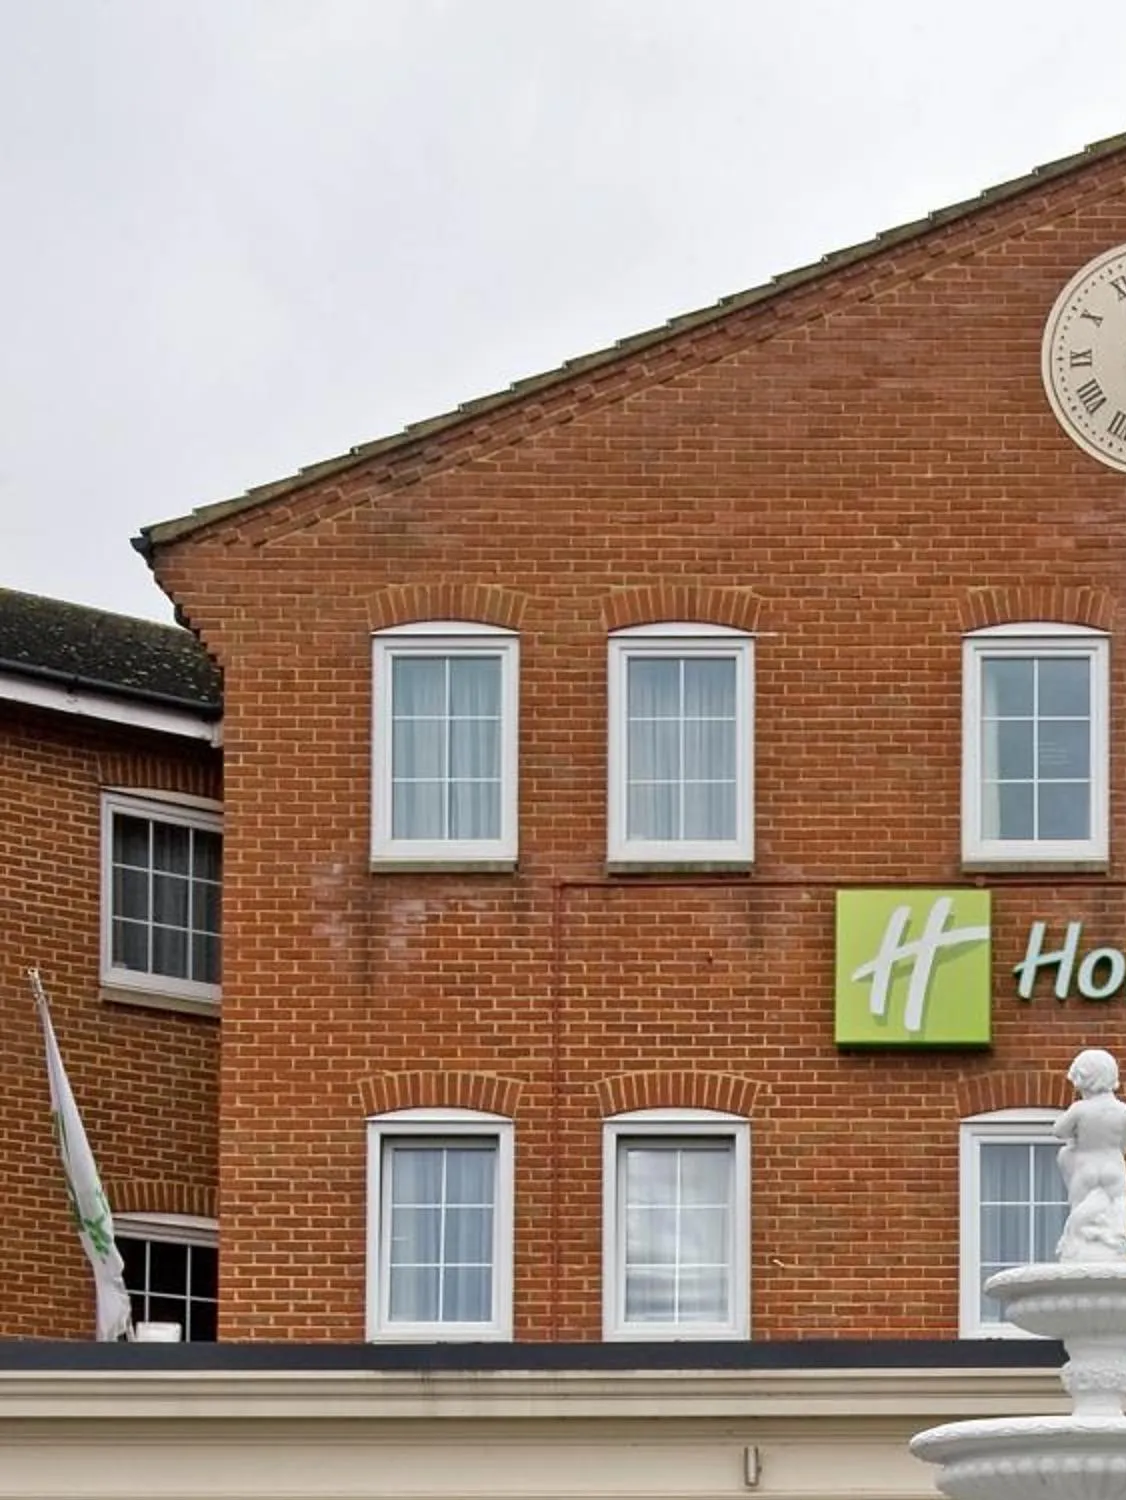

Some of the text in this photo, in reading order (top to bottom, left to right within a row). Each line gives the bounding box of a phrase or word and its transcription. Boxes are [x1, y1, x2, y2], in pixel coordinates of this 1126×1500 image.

[1080, 308, 1104, 328] X
[1069, 349, 1093, 368] IX
[1076, 378, 1107, 416] VIII
[852, 896, 990, 1032] H
